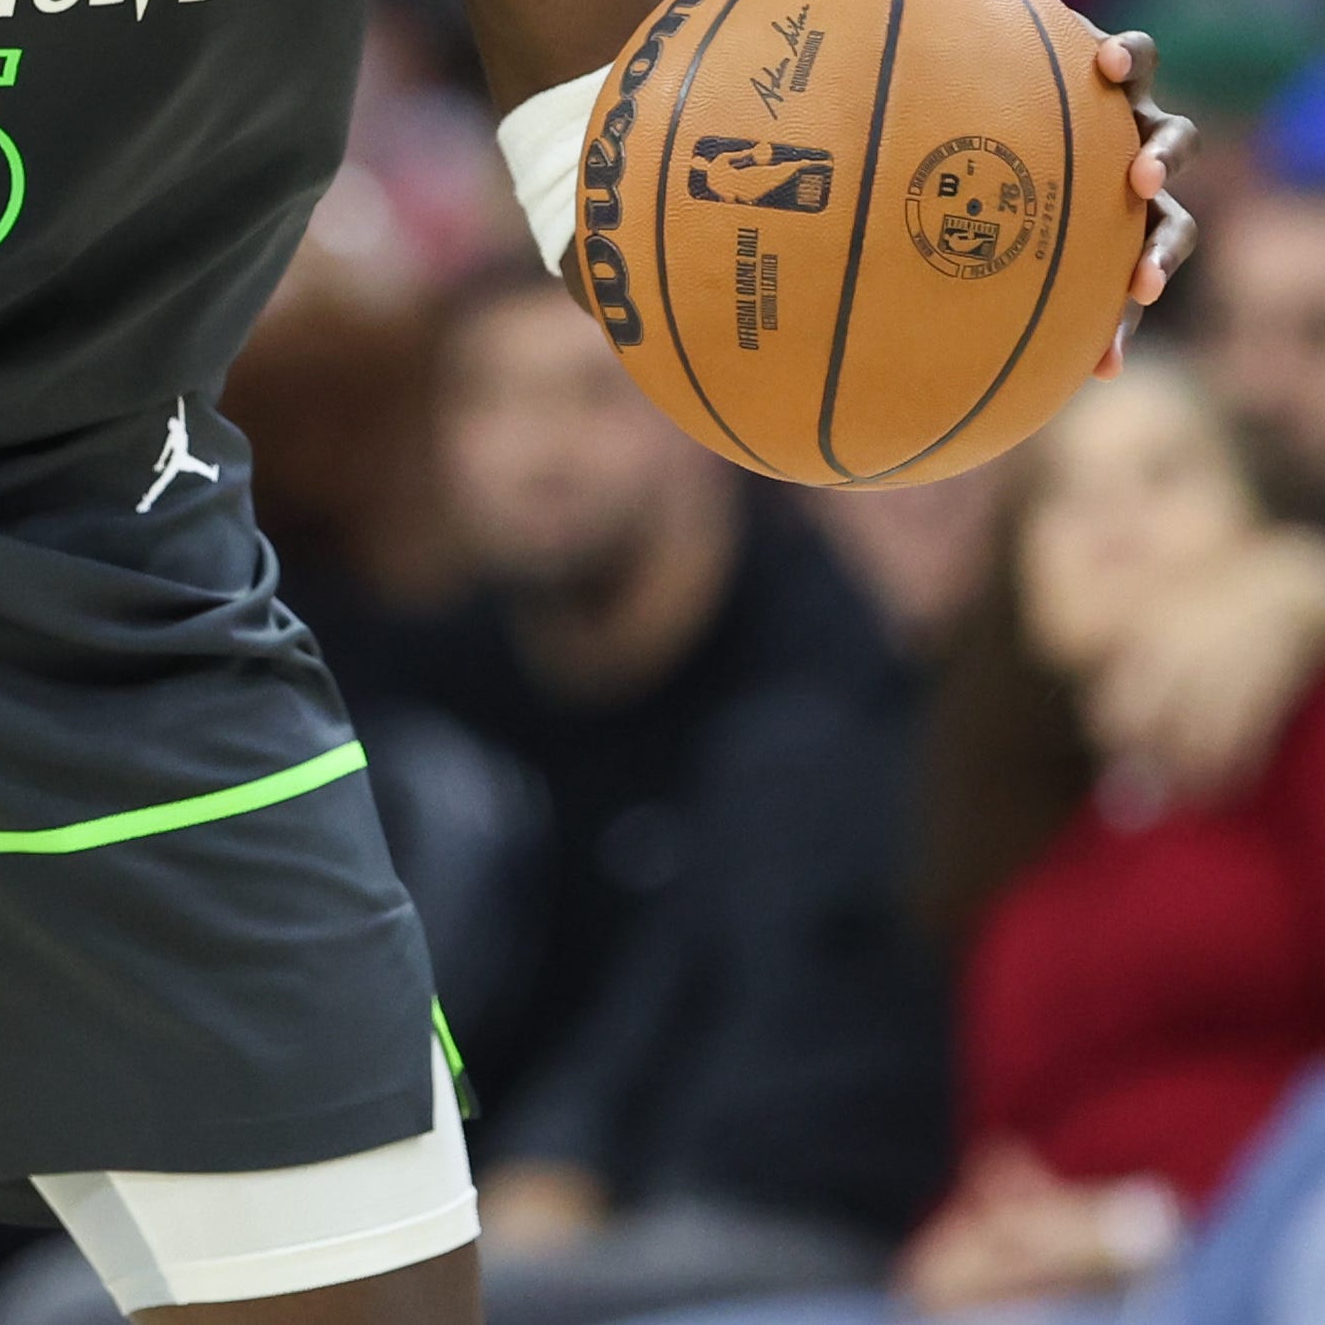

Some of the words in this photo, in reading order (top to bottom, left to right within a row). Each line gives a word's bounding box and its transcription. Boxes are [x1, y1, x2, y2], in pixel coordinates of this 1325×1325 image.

[736, 227, 760, 258] BALL
[735, 258, 757, 296] GAME
[760, 253, 778, 292] LEATHER
[736, 298, 759, 350] OFFICIAL
